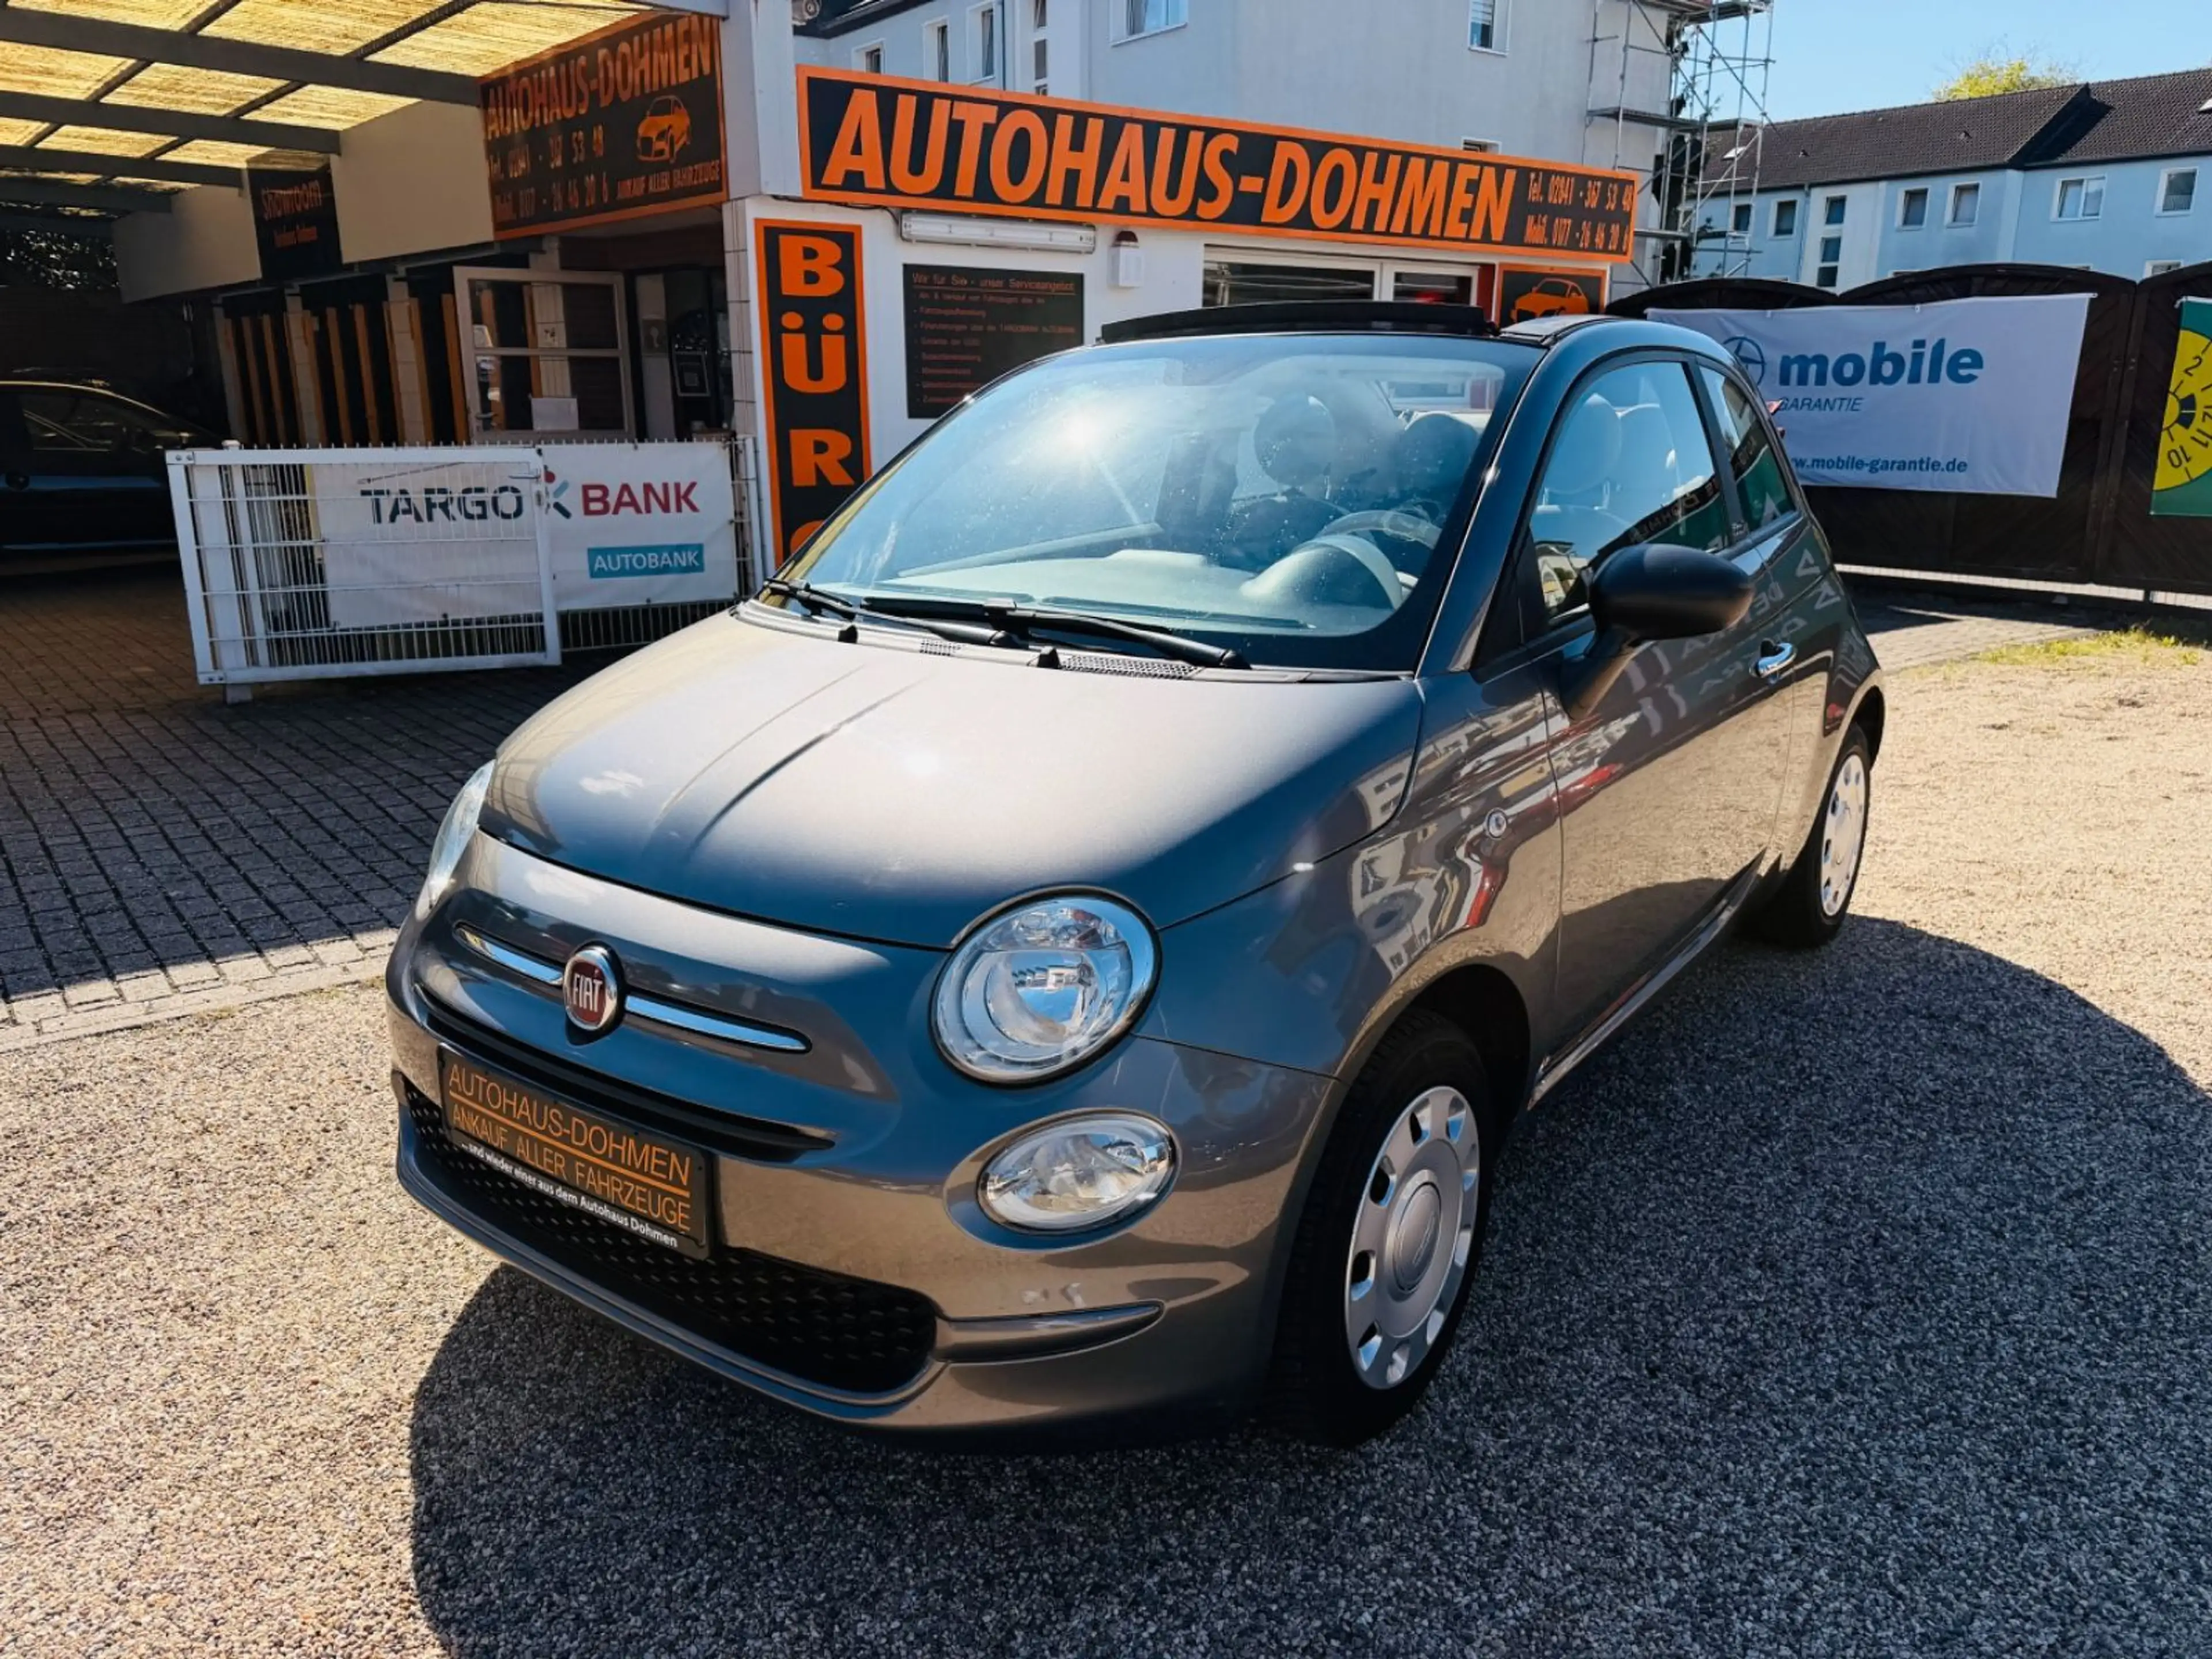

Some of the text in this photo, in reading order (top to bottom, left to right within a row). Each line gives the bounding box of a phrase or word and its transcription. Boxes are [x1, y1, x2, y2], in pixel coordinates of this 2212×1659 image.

[487, 15, 711, 140] AUTOHAUS-DOHMEN
[821, 89, 1517, 242] AUTOHAUS-DOHMEN
[1528, 171, 1543, 203] Tel.
[1778, 338, 1984, 387] mobile
[2183, 355, 2202, 377] 2
[778, 234, 855, 554] BÜR
[2167, 444, 2192, 469] 10
[361, 481, 700, 525] TARGO BANK
[593, 551, 699, 572] AUTOBANK
[573, 972, 604, 1013] FIAT
[448, 1063, 691, 1187] AUTOHAUS-DOHMEN
[452, 1104, 691, 1233] ANKAUF ALLER FAHRZEUGE
[486, 1152, 513, 1173] wieder
[538, 1179, 555, 1195] aus
[555, 1184, 578, 1205] dem
[579, 1195, 629, 1227] Autohaus
[630, 1217, 678, 1248] Dohmen
